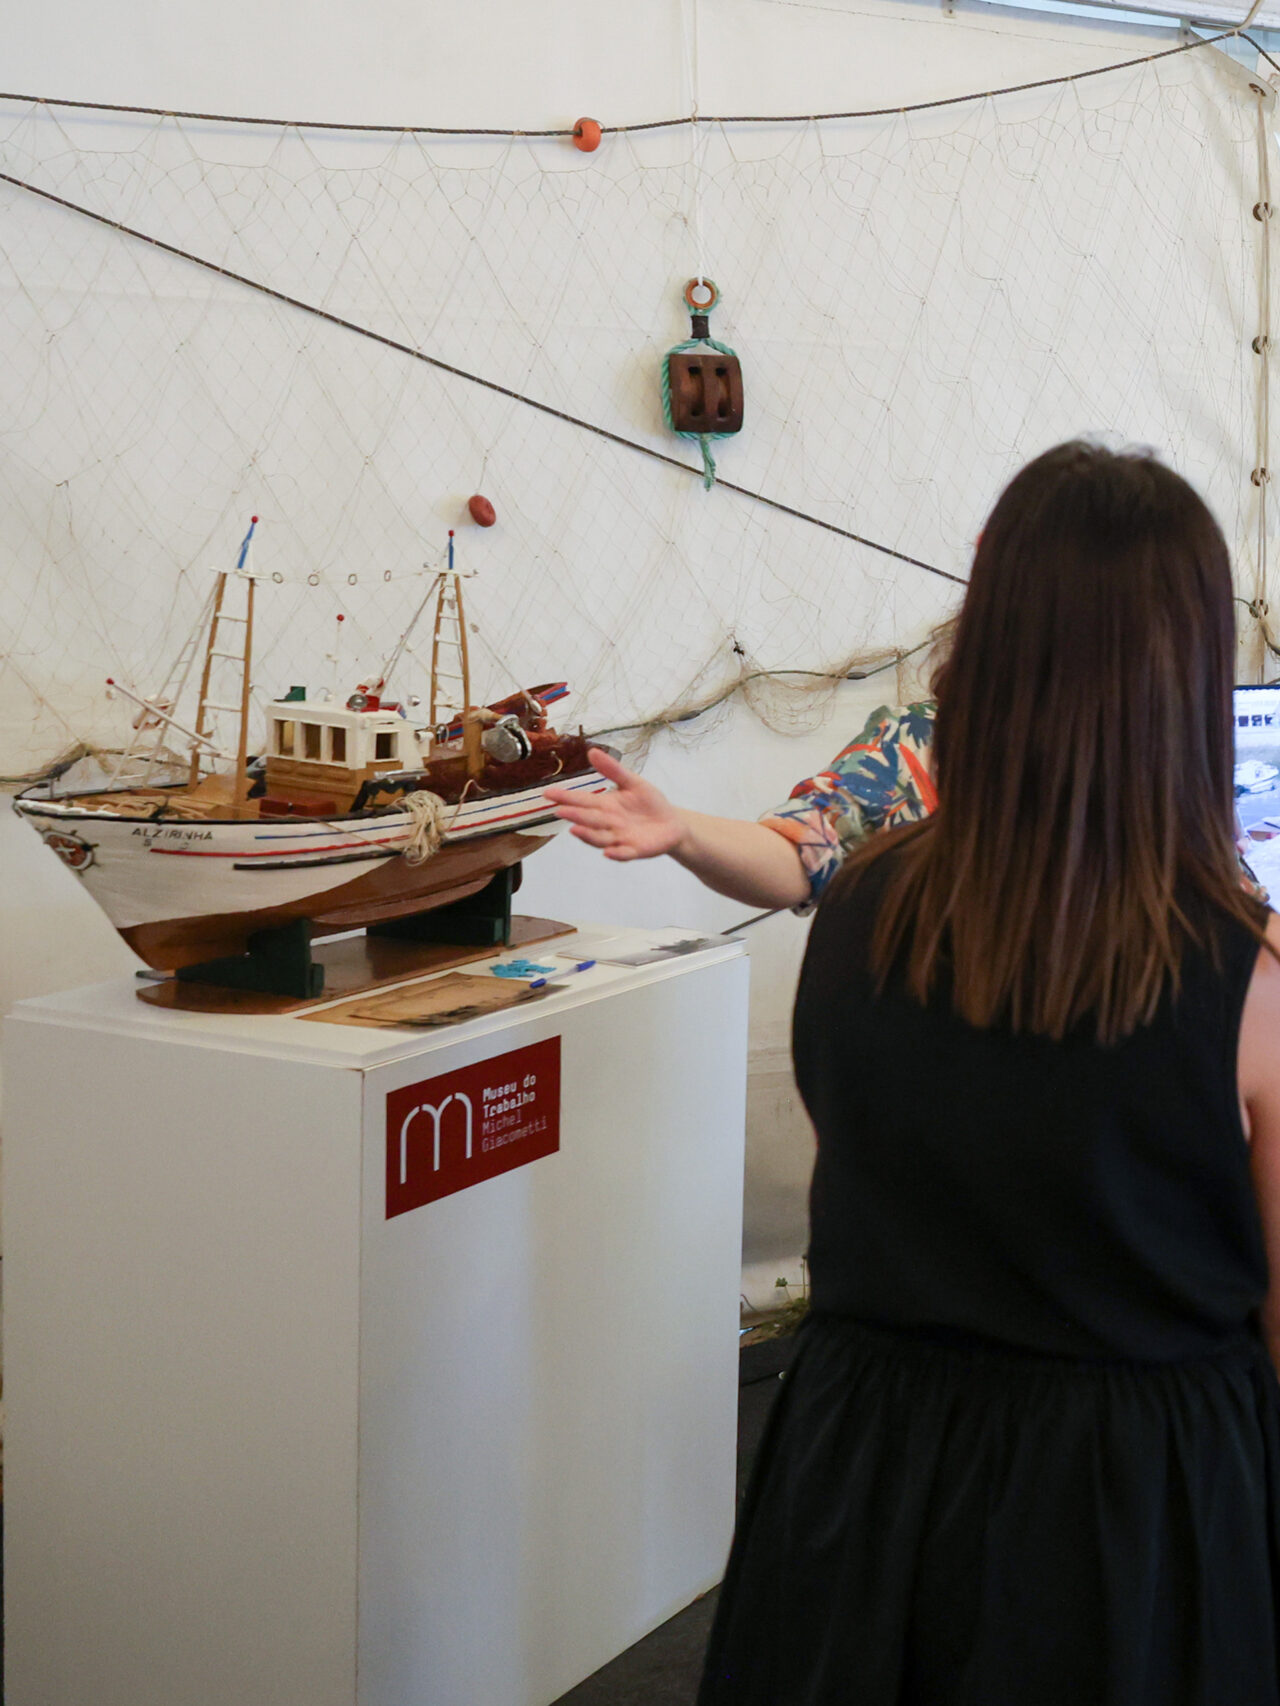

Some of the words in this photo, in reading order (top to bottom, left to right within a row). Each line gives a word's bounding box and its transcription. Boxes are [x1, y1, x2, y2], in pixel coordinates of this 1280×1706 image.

[482, 1082, 517, 1102] Museu
[523, 1074, 536, 1088] do
[483, 1091, 536, 1118] Trabalho
[482, 1109, 521, 1135] Michel
[482, 1116, 548, 1152] Giacometti
